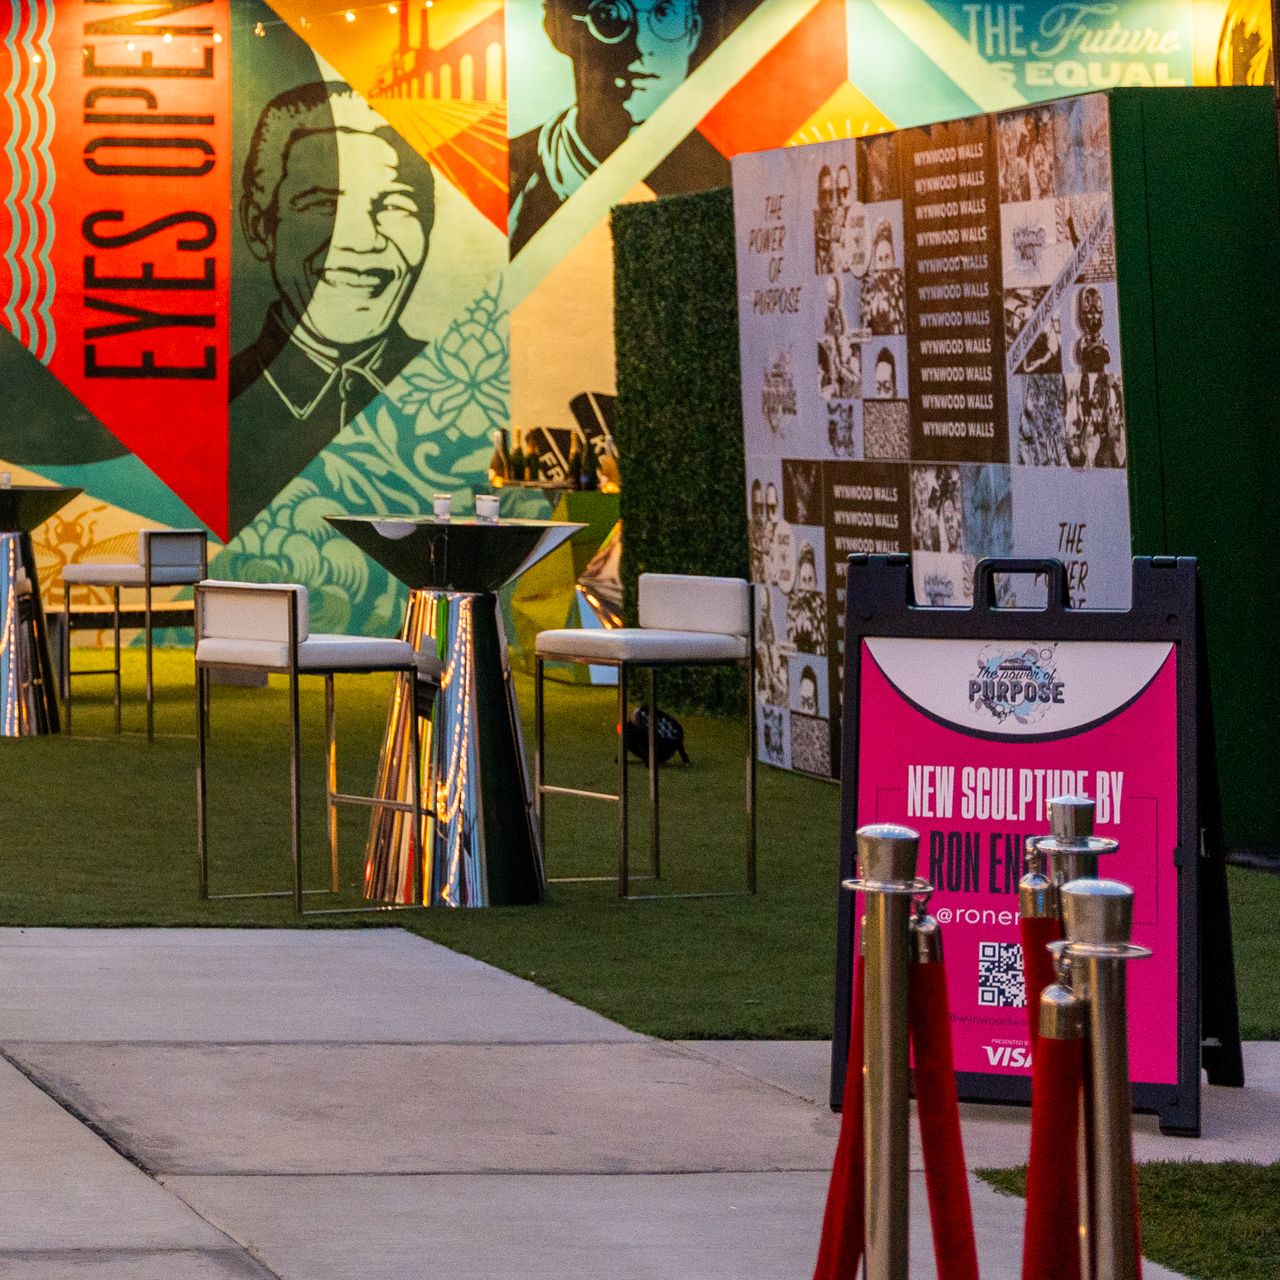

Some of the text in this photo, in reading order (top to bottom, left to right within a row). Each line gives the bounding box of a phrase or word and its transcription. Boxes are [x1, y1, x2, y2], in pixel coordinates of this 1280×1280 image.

[962, 2, 1182, 58] THE Future
[1025, 61, 1185, 88] EQUAL
[914, 142, 983, 166] WYNWOOD WALLS
[915, 170, 985, 193] WYNWOOD WALLS
[764, 194, 784, 220] THE
[915, 198, 986, 219] WYNWOOD WALLS
[749, 225, 785, 254] POWER
[916, 226, 987, 247] WYNWOOD WALLS
[768, 257, 784, 283] OF
[918, 254, 988, 273] WYNWOOD WALLS
[82, 210, 217, 380] EYES
[753, 286, 802, 315] PURPOSE
[918, 282, 989, 300] WYNWOOD WALLS
[919, 310, 990, 328] WYNWOOD WALLS
[920, 338, 991, 355] WYNWOOD WALLS
[921, 366, 992, 382] WYNWOOD WALLS
[921, 394, 993, 409] WYNWOOD WALLS
[923, 421, 994, 438] WYNWOOD WALLS
[833, 484, 898, 502] WYNWOOD WALLS
[834, 510, 898, 529] WYNWOOD WALLS
[1059, 521, 1086, 554] THE
[977, 665, 1057, 686] The power of
[968, 680, 1065, 704] PURPOSE
[908, 765, 955, 818] NEW
[1096, 771, 1124, 825] BY
[930, 830, 980, 893] RON
